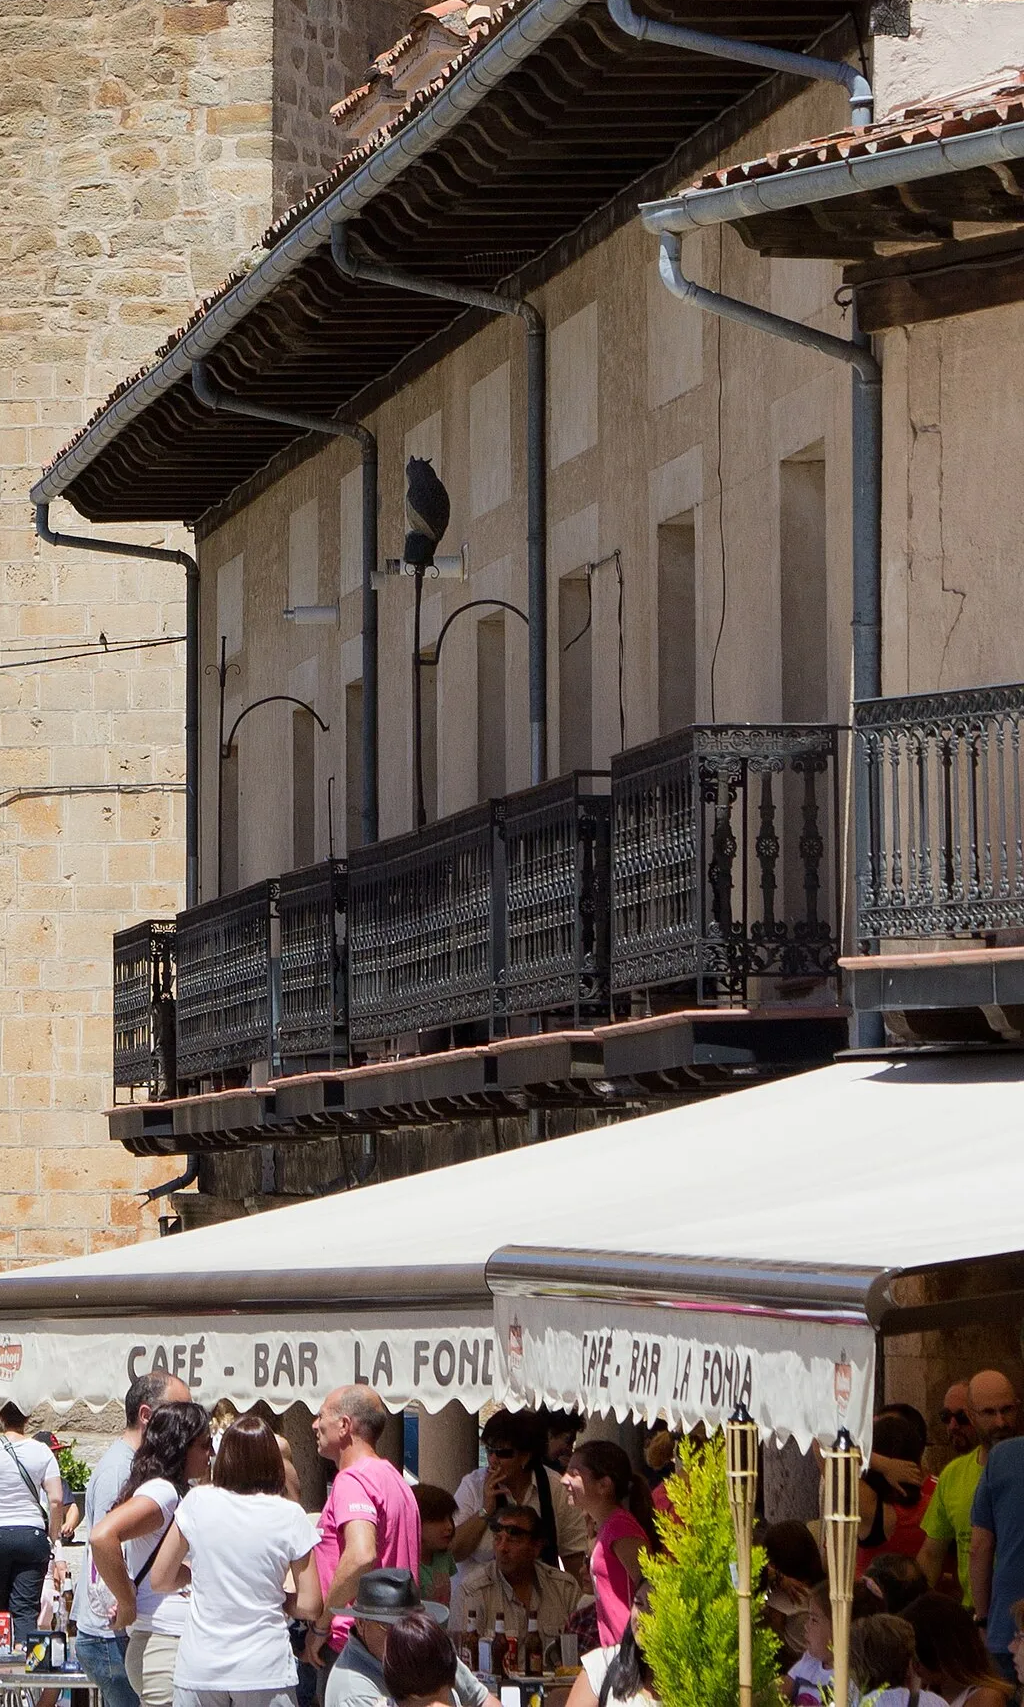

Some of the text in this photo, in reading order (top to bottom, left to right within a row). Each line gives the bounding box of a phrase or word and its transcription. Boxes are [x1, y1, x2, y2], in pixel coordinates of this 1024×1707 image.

[128, 1336, 205, 1388] CAFÉ
[254, 1341, 318, 1388] BAR
[354, 1340, 393, 1387] LA
[629, 1339, 662, 1397] BAR
[673, 1345, 692, 1401] LA
